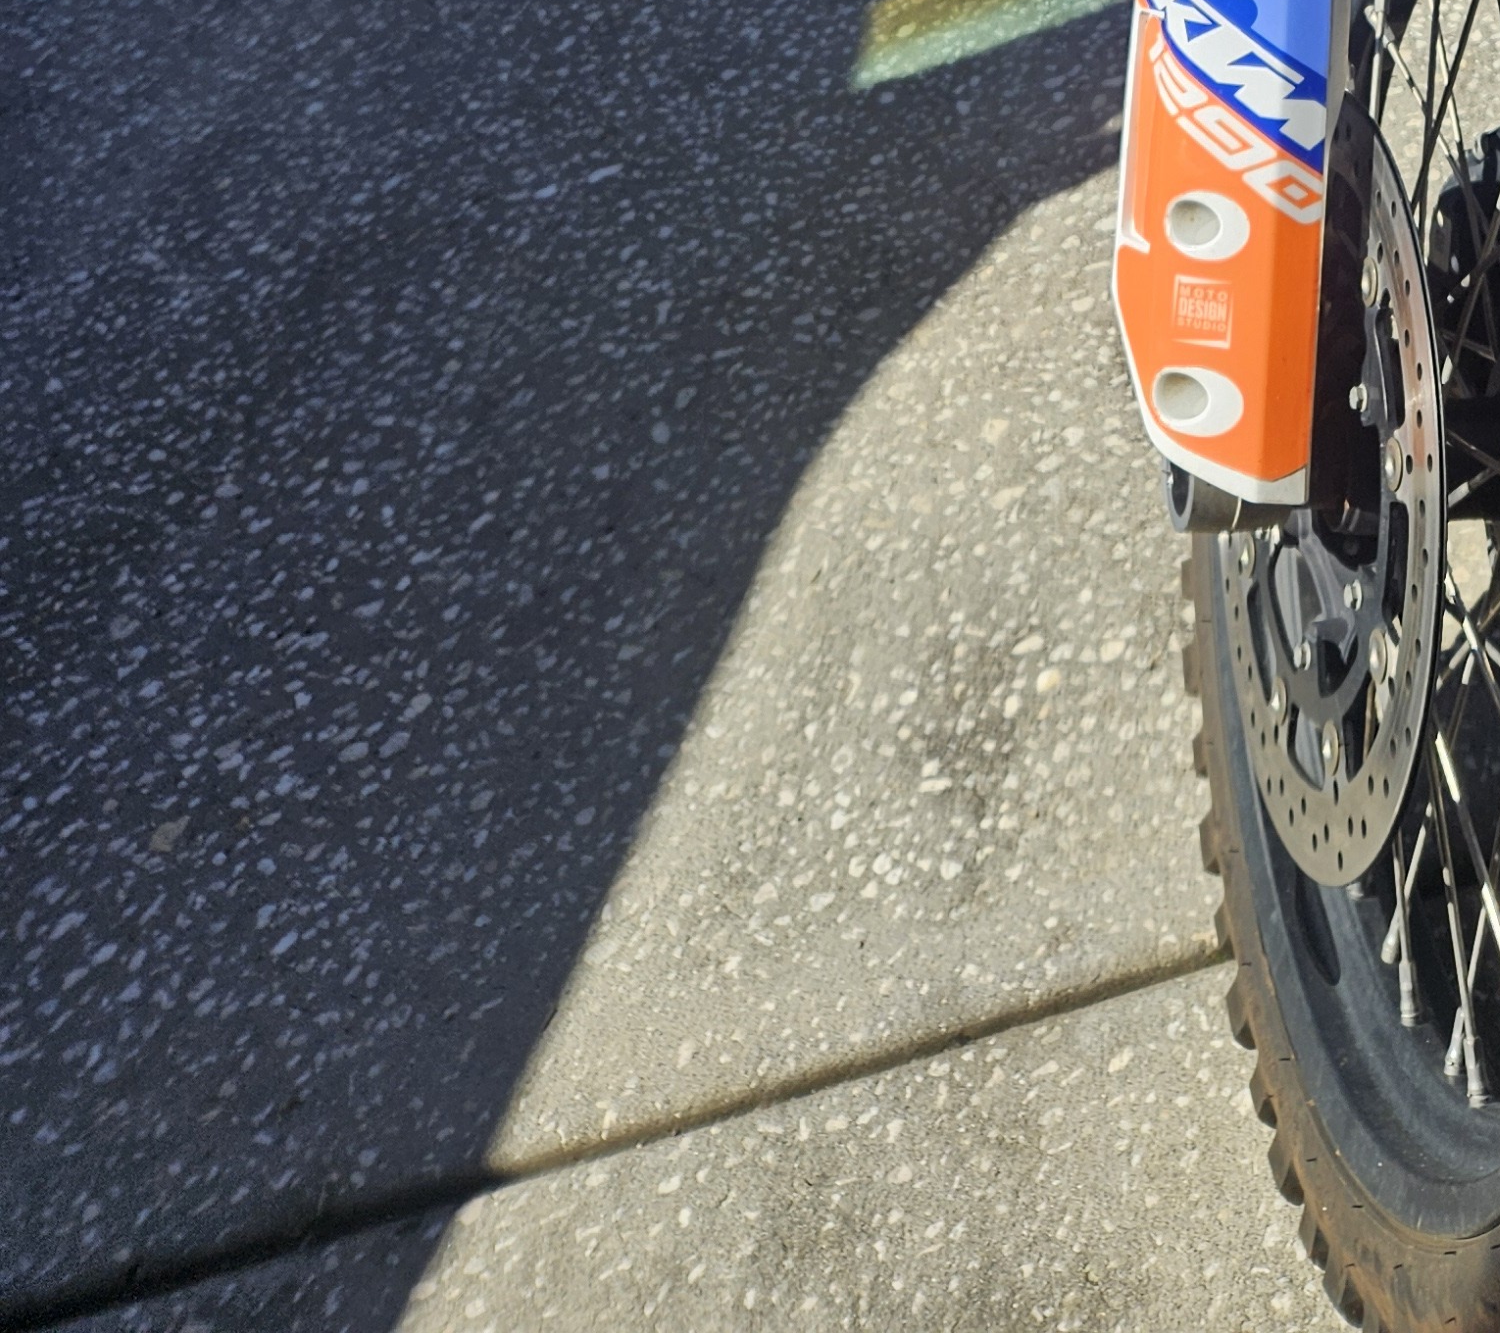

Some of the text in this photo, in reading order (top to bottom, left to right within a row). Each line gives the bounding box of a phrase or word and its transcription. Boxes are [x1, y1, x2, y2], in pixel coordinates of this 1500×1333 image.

[1148, 25, 1325, 225] 1290
[1179, 284, 1228, 302] MOTO
[1178, 297, 1228, 322] DESIGN
[1177, 316, 1227, 333] STUDIO
